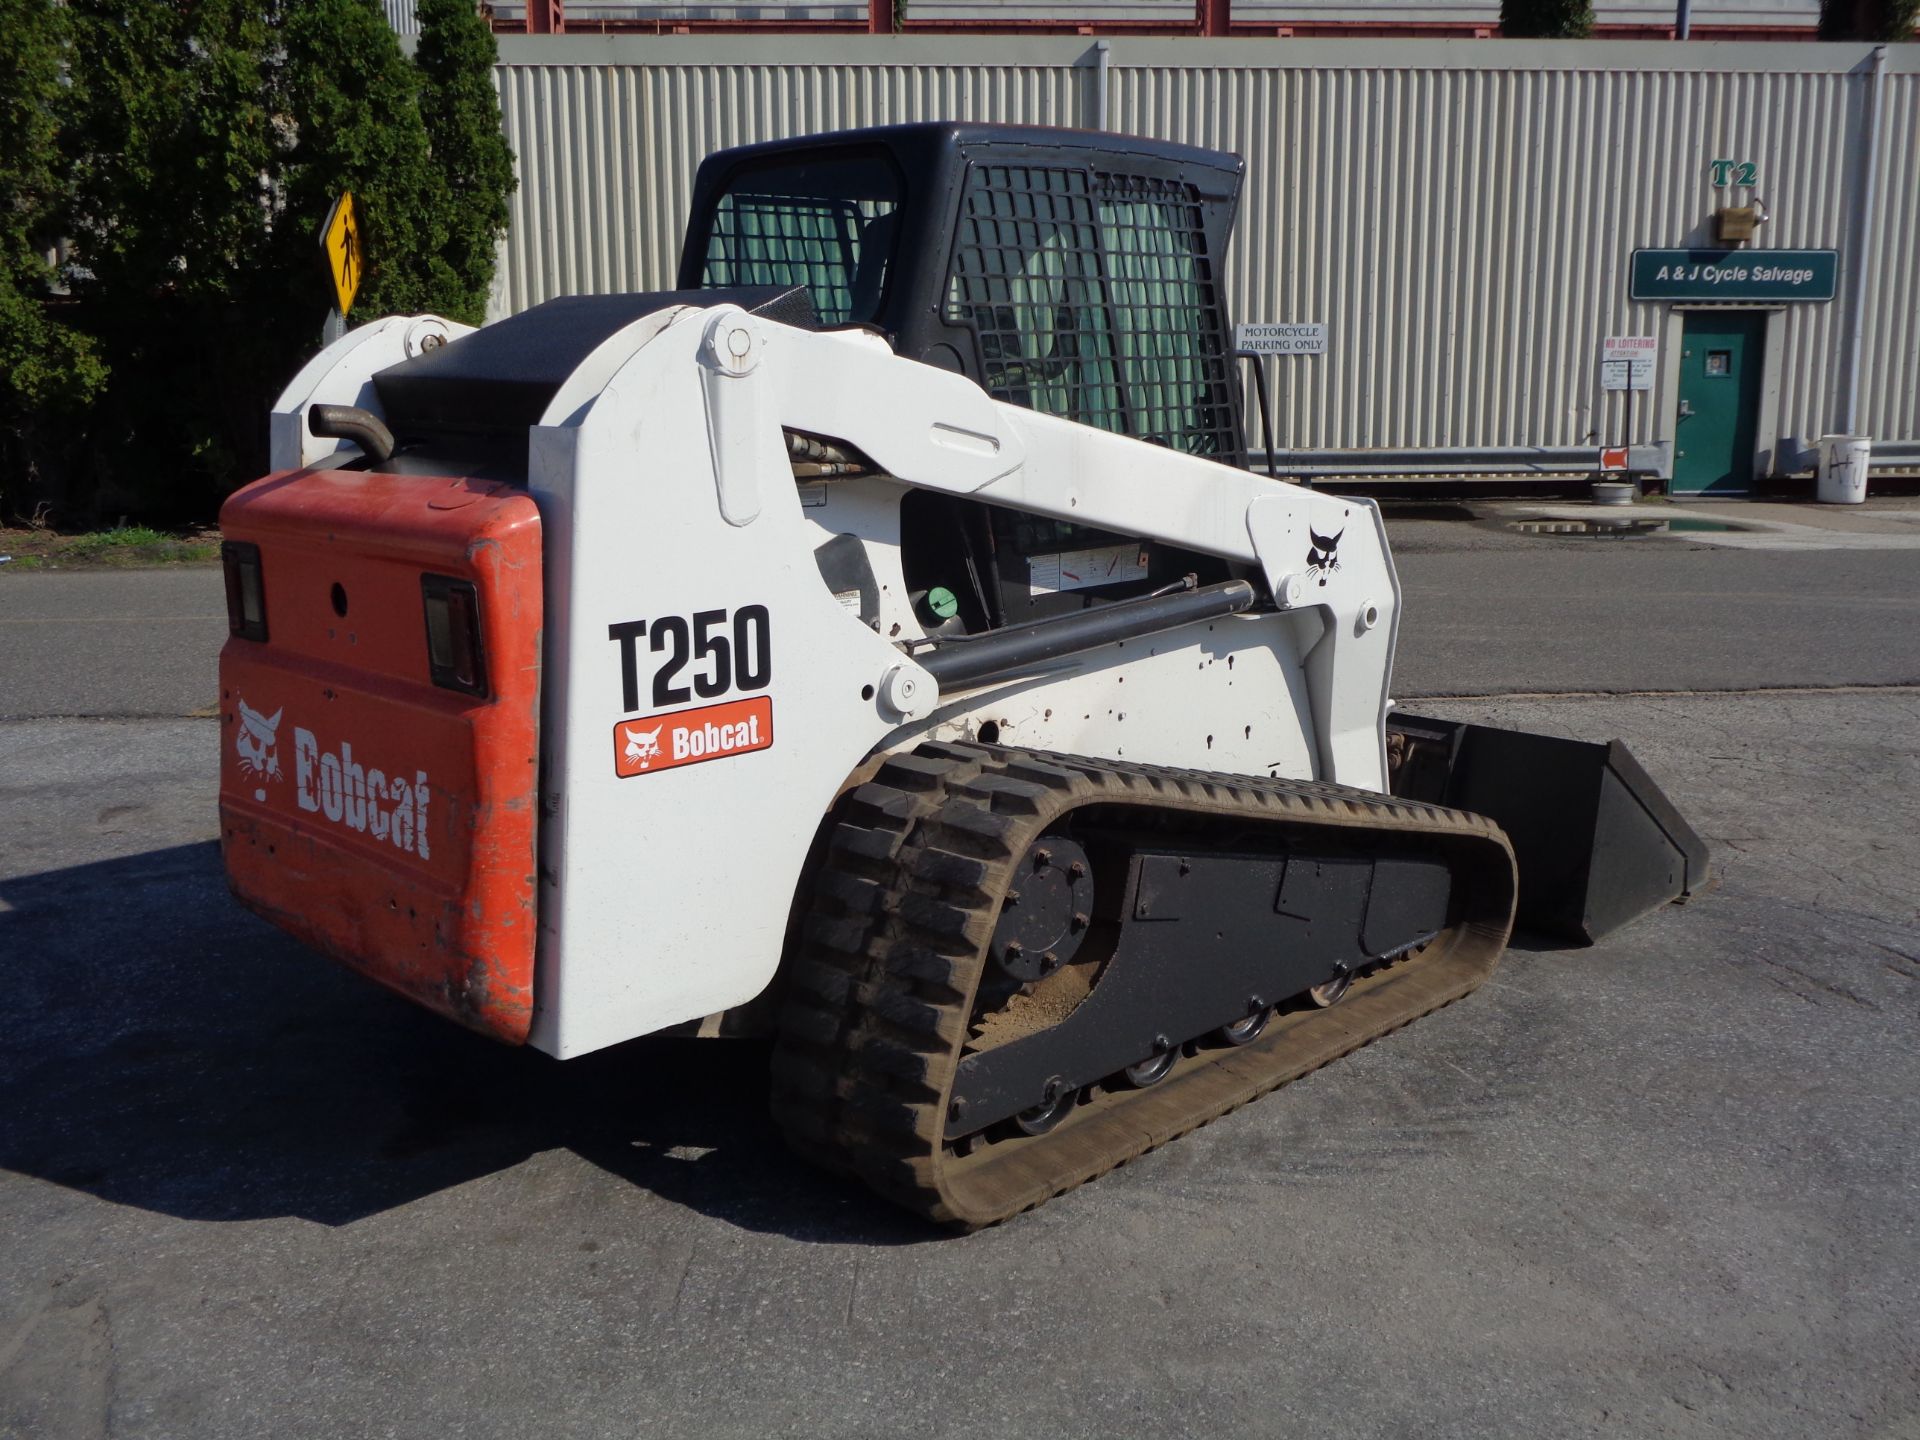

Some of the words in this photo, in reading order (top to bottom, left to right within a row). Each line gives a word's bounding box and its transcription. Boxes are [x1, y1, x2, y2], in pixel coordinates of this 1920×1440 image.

[1656, 266, 1668, 280] A
[1673, 266, 1684, 281] &
[1689, 266, 1700, 281] J
[1703, 266, 1747, 285] Cycle
[1752, 266, 1813, 285] Salvage
[1245, 327, 1319, 337] MOTORCYCLE
[1241, 340, 1290, 350] PARKING
[1294, 340, 1322, 350] ONLY
[1605, 338, 1616, 349] NO
[1618, 338, 1655, 349] LOITERING
[608, 604, 772, 713] T250
[672, 714, 760, 761] Bobcat
[294, 726, 430, 861] Bobcat
